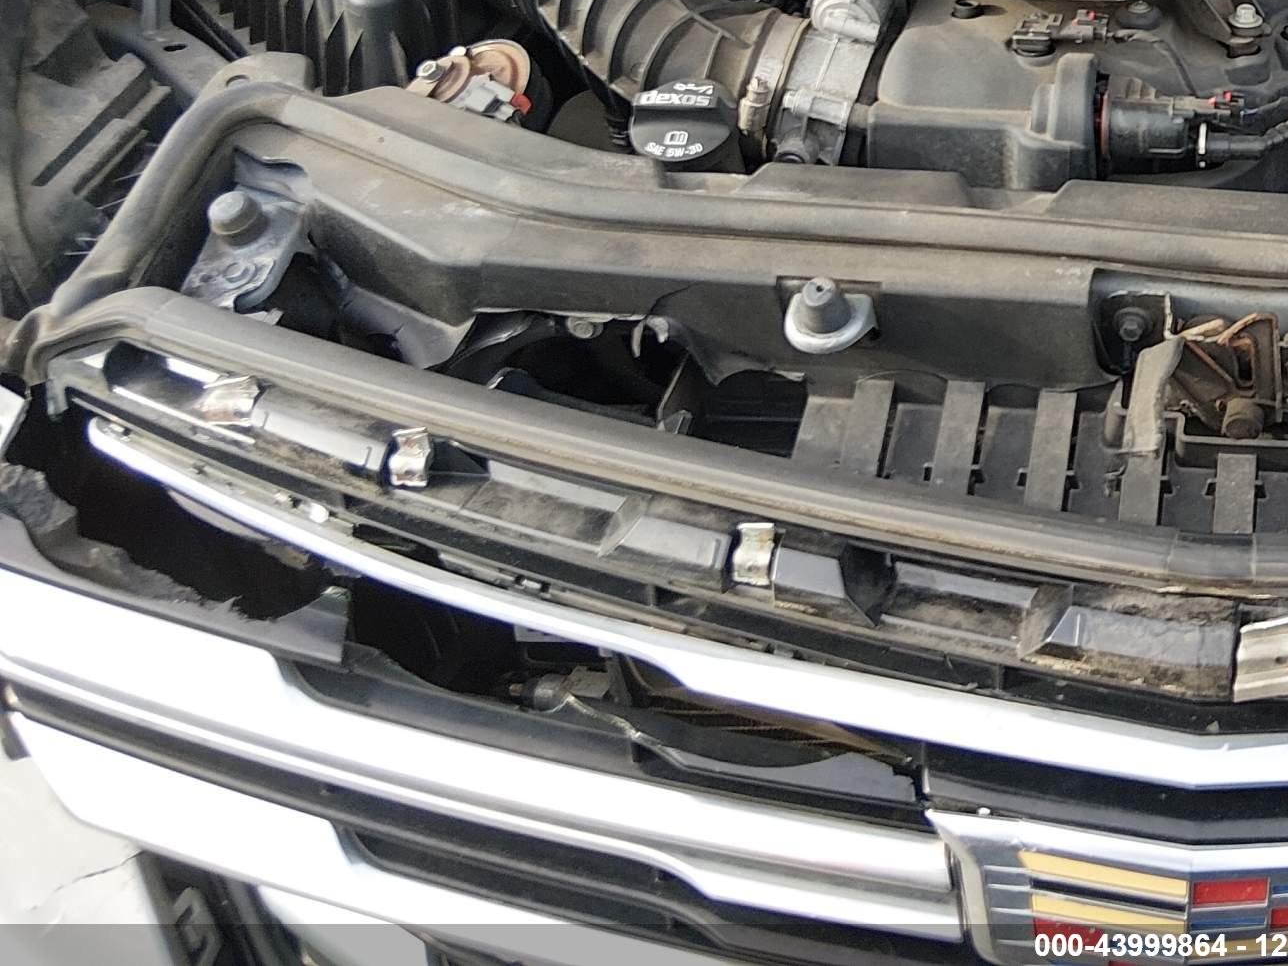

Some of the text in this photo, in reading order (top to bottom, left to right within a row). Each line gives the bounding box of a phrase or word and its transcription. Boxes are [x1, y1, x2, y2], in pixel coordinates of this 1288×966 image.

[639, 90, 710, 107] dexos
[644, 141, 703, 158] SAE 5W-30
